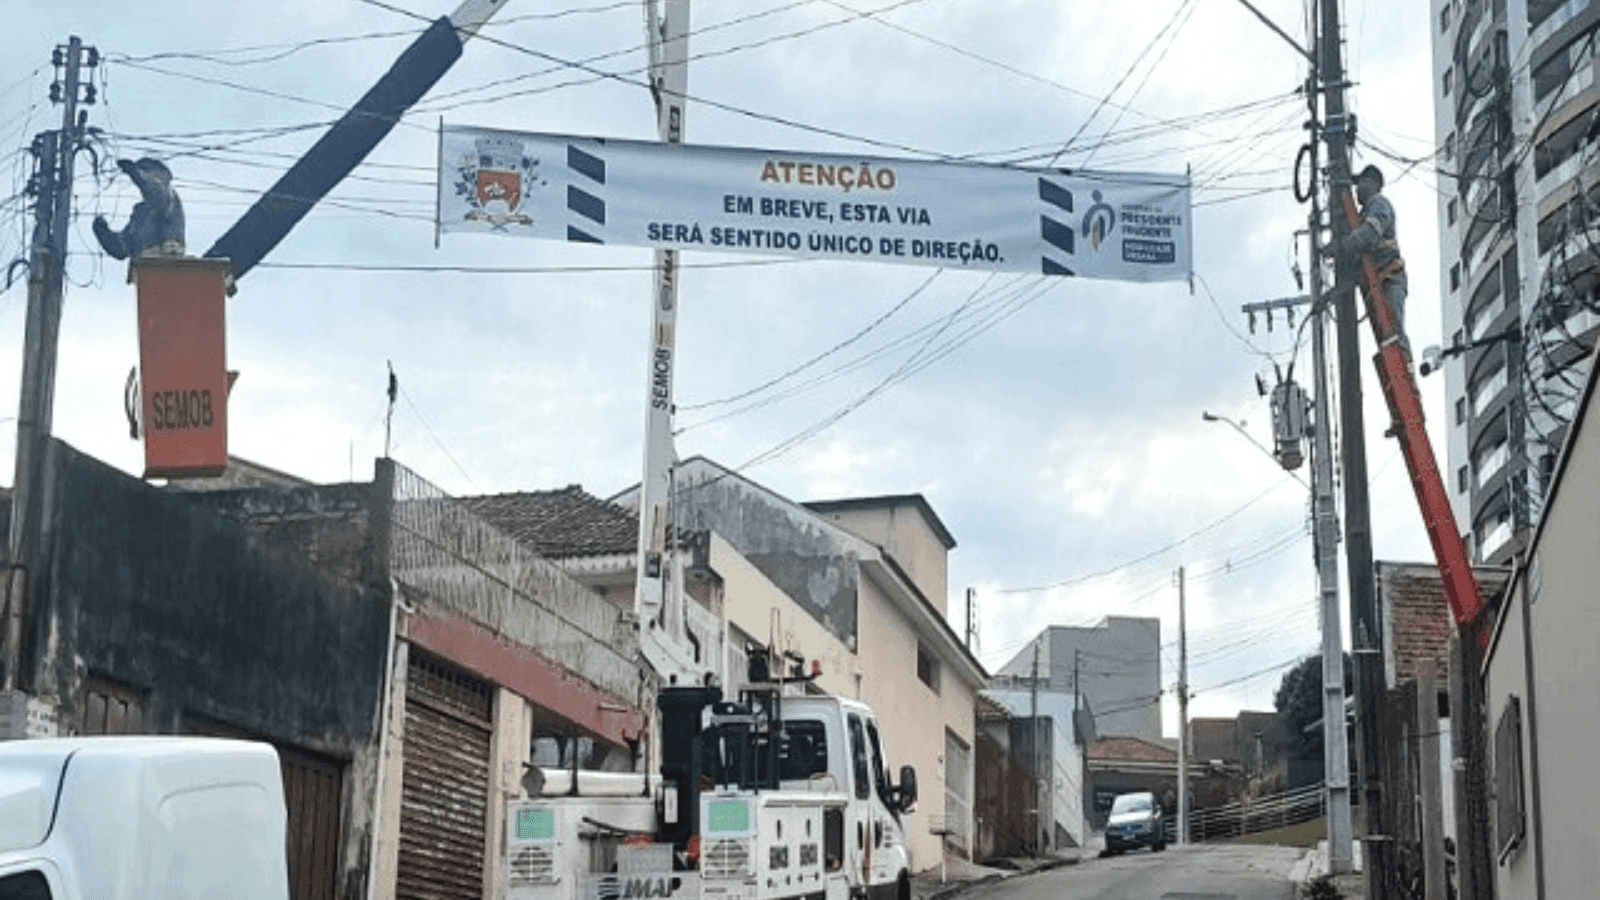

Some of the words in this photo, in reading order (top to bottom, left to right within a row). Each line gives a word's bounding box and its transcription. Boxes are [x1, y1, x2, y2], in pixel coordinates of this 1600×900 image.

[761, 161, 896, 193] ATENÇÃO
[724, 195, 753, 215] EM
[760, 197, 833, 224] BREVE,
[840, 202, 891, 224] ESTA
[897, 206, 931, 226] VIA
[647, 222, 703, 244] SERÁ
[710, 227, 801, 250] SENTIDO
[808, 229, 873, 254] ÚNICO
[879, 237, 905, 256] DE
[912, 238, 1004, 265] DIREÇÃO.
[653, 347, 670, 411] SEMOB
[152, 389, 213, 430] SEMOB
